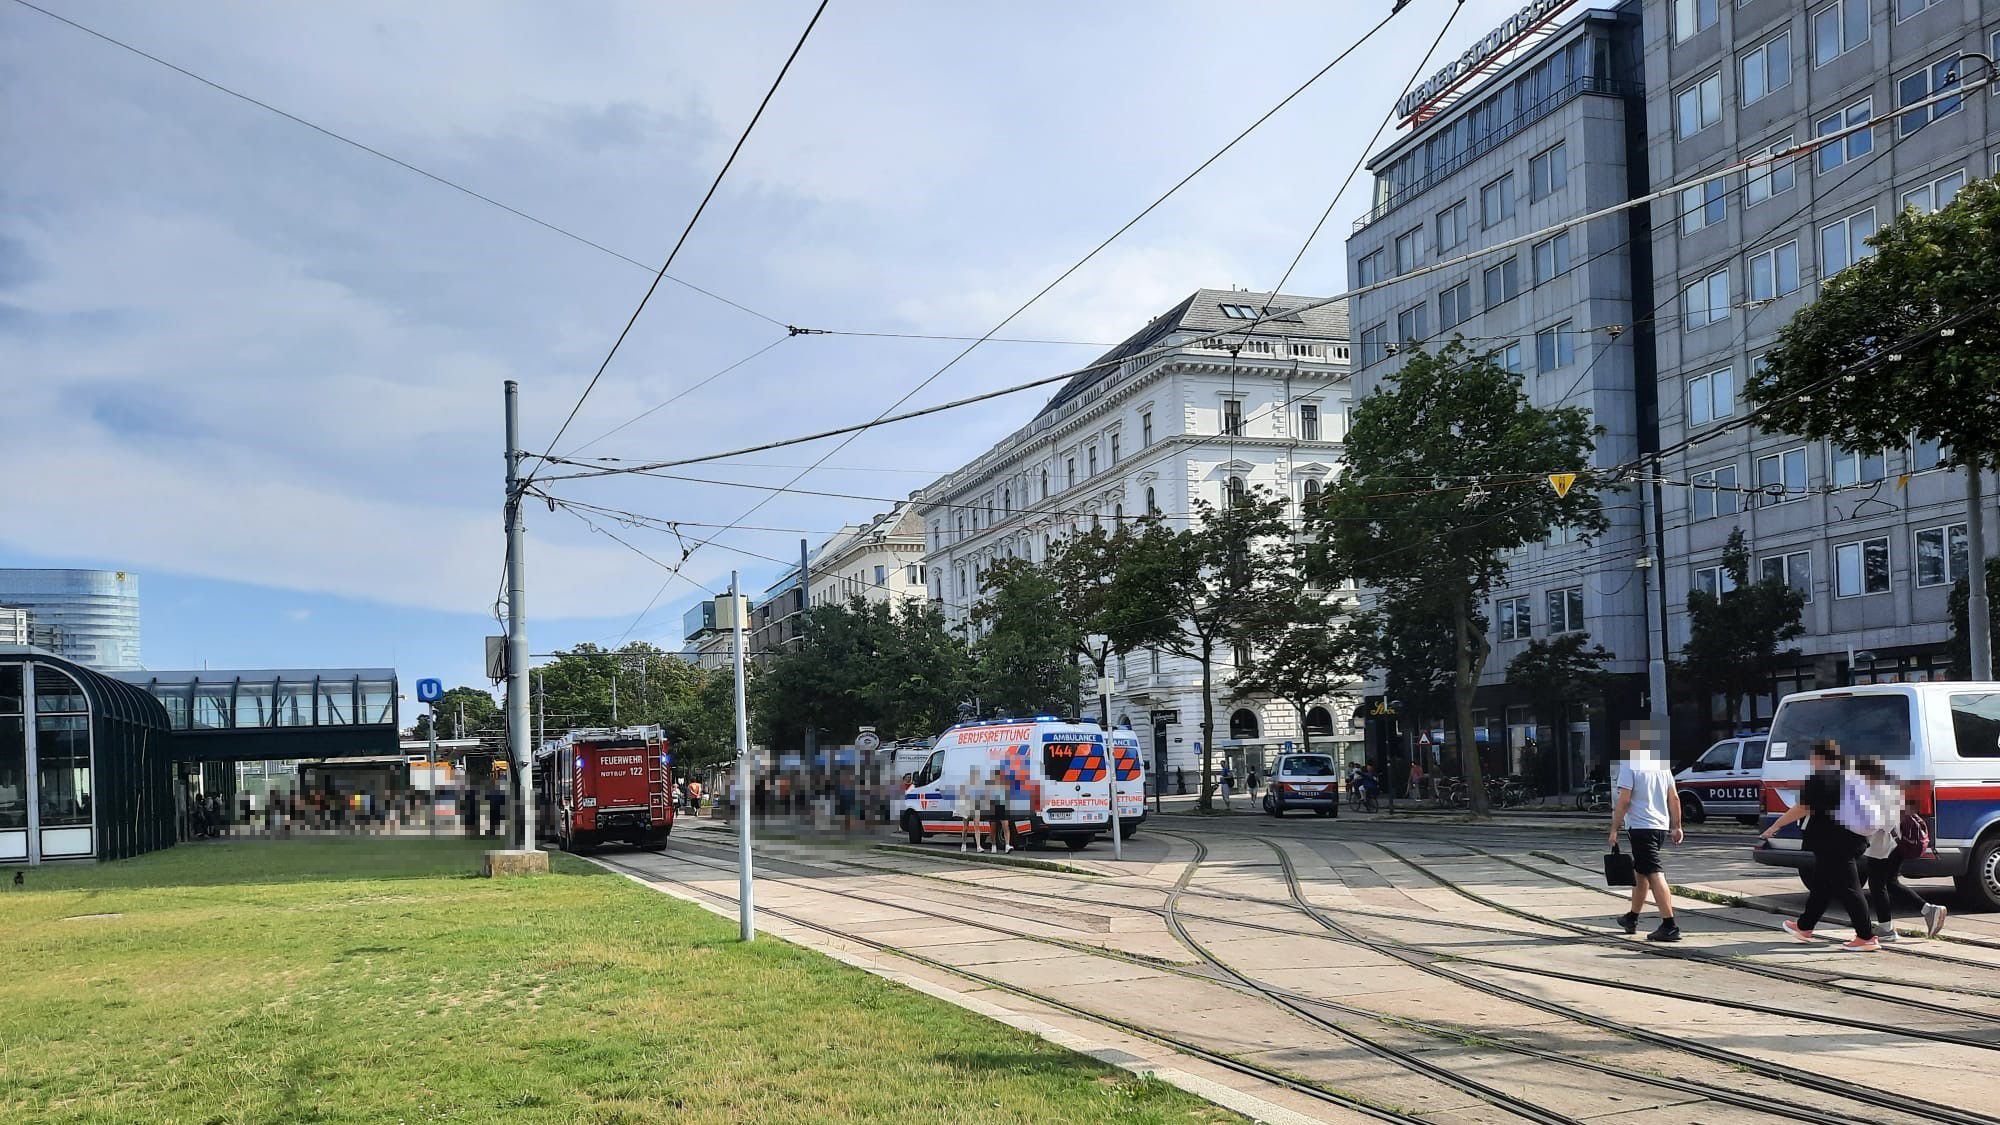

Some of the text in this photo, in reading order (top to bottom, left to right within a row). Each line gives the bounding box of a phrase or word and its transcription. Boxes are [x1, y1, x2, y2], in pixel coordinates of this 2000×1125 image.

[1395, 0, 1560, 120] WIENER STÄDTISCH
[422, 683, 438, 698] U
[957, 728, 1031, 744] BERUFSRETTUNG
[1053, 733, 1097, 742] AMBULANCE
[1048, 745, 1073, 758] 144
[600, 756, 643, 765] FEUERWEHR
[630, 767, 643, 776] 122
[1709, 788, 1758, 798] POLIZEI
